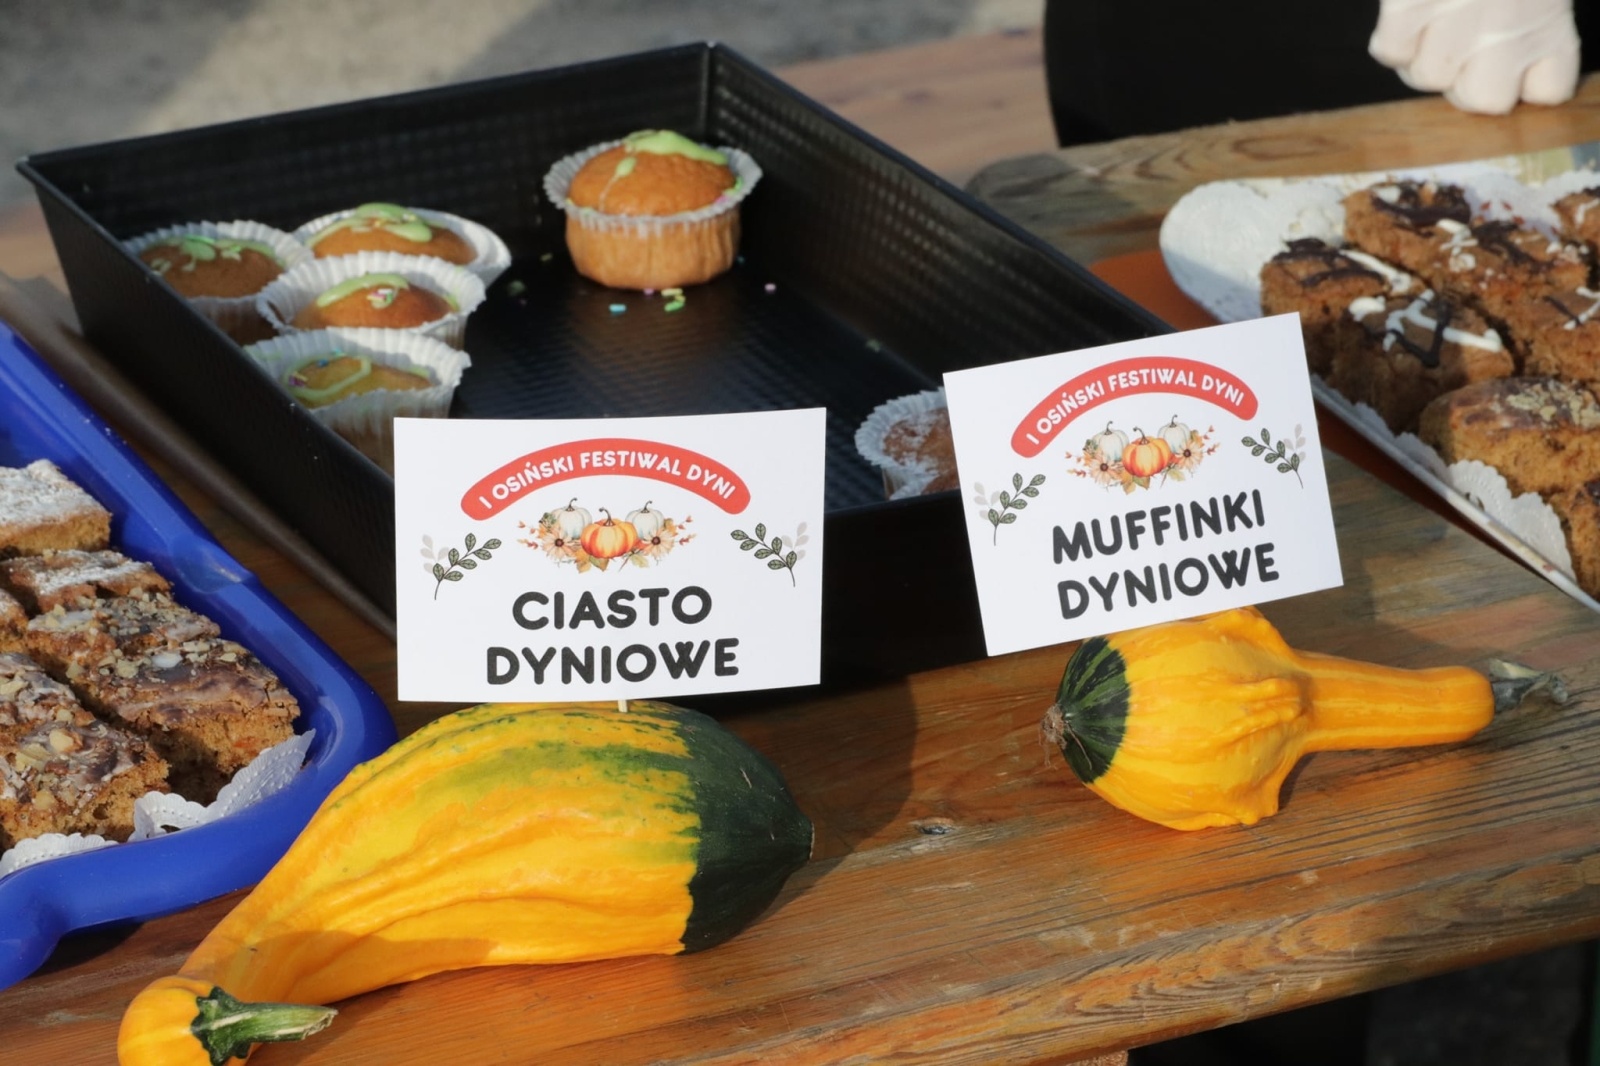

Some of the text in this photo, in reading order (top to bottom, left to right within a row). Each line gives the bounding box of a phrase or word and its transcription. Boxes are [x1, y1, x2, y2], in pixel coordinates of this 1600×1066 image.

[1026, 369, 1246, 445] I OSIŃSKI FESTIWAL DYNI
[479, 450, 736, 509] I OSIŃSKI FESTIWAL DYNI
[1052, 488, 1265, 564] MUFFINKI
[512, 585, 712, 630] CIASTO
[1057, 542, 1280, 619] DYNIOWE
[486, 637, 739, 685] DYNIOWE
